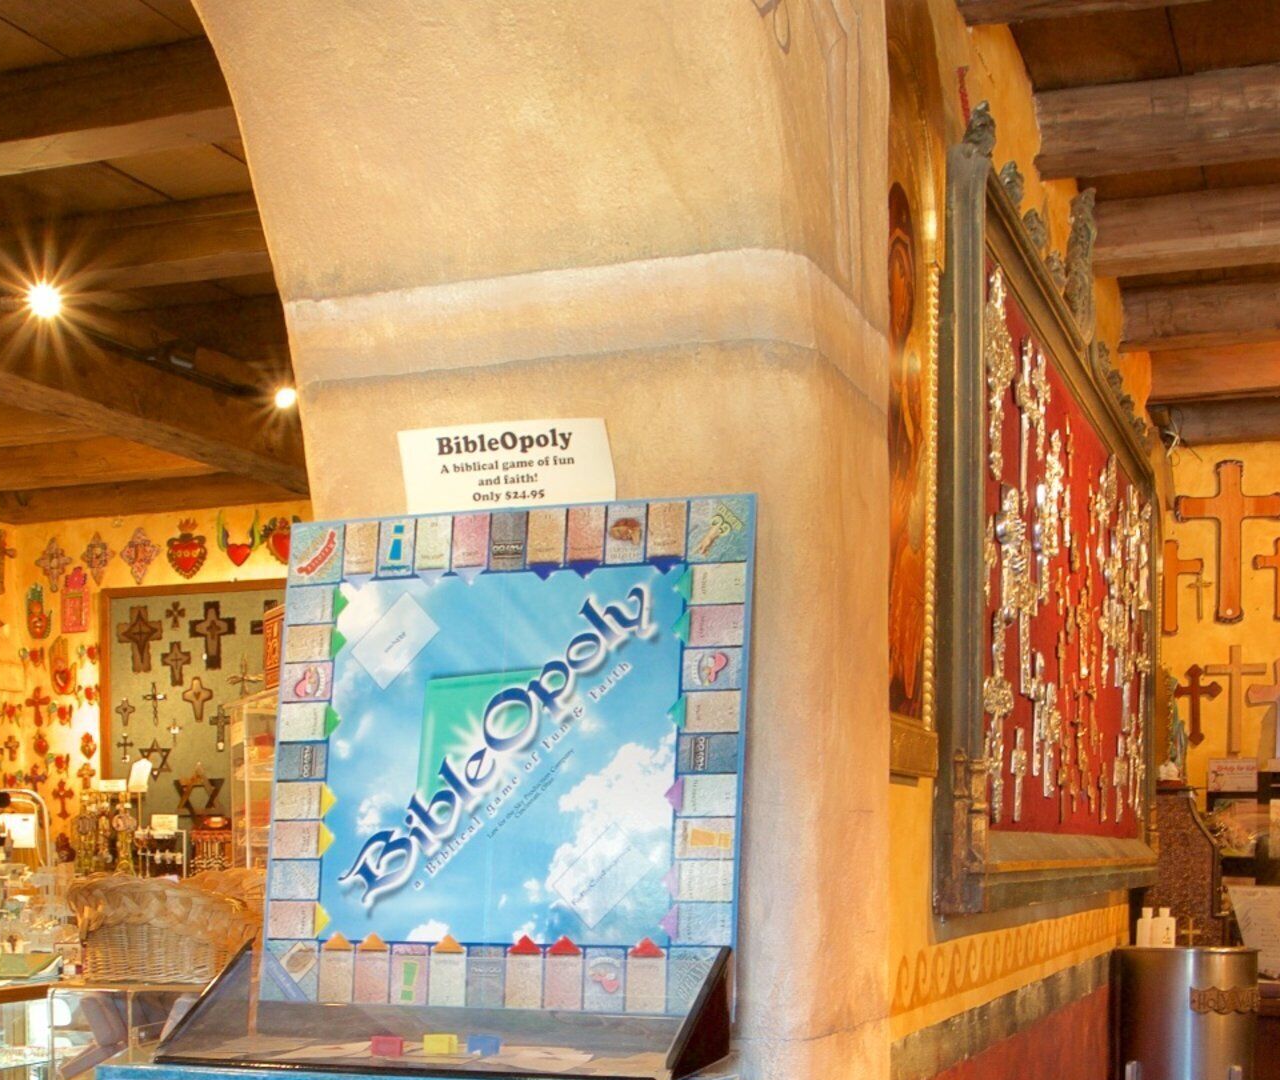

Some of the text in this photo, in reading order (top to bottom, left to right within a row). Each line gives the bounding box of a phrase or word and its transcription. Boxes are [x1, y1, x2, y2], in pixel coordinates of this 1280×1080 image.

[436, 428, 573, 456] BibleOpoly
[441, 455, 575, 474] A biblical game of fun
[478, 474, 538, 487] and faith!
[472, 489, 545, 503] Only $24.95
[338, 586, 646, 905] BibleOpoly
[425, 815, 481, 875] Biblical
[485, 775, 520, 815] game
[523, 752, 540, 771] of
[541, 724, 569, 750] Fun
[573, 706, 584, 718] &
[589, 661, 630, 700] Faith
